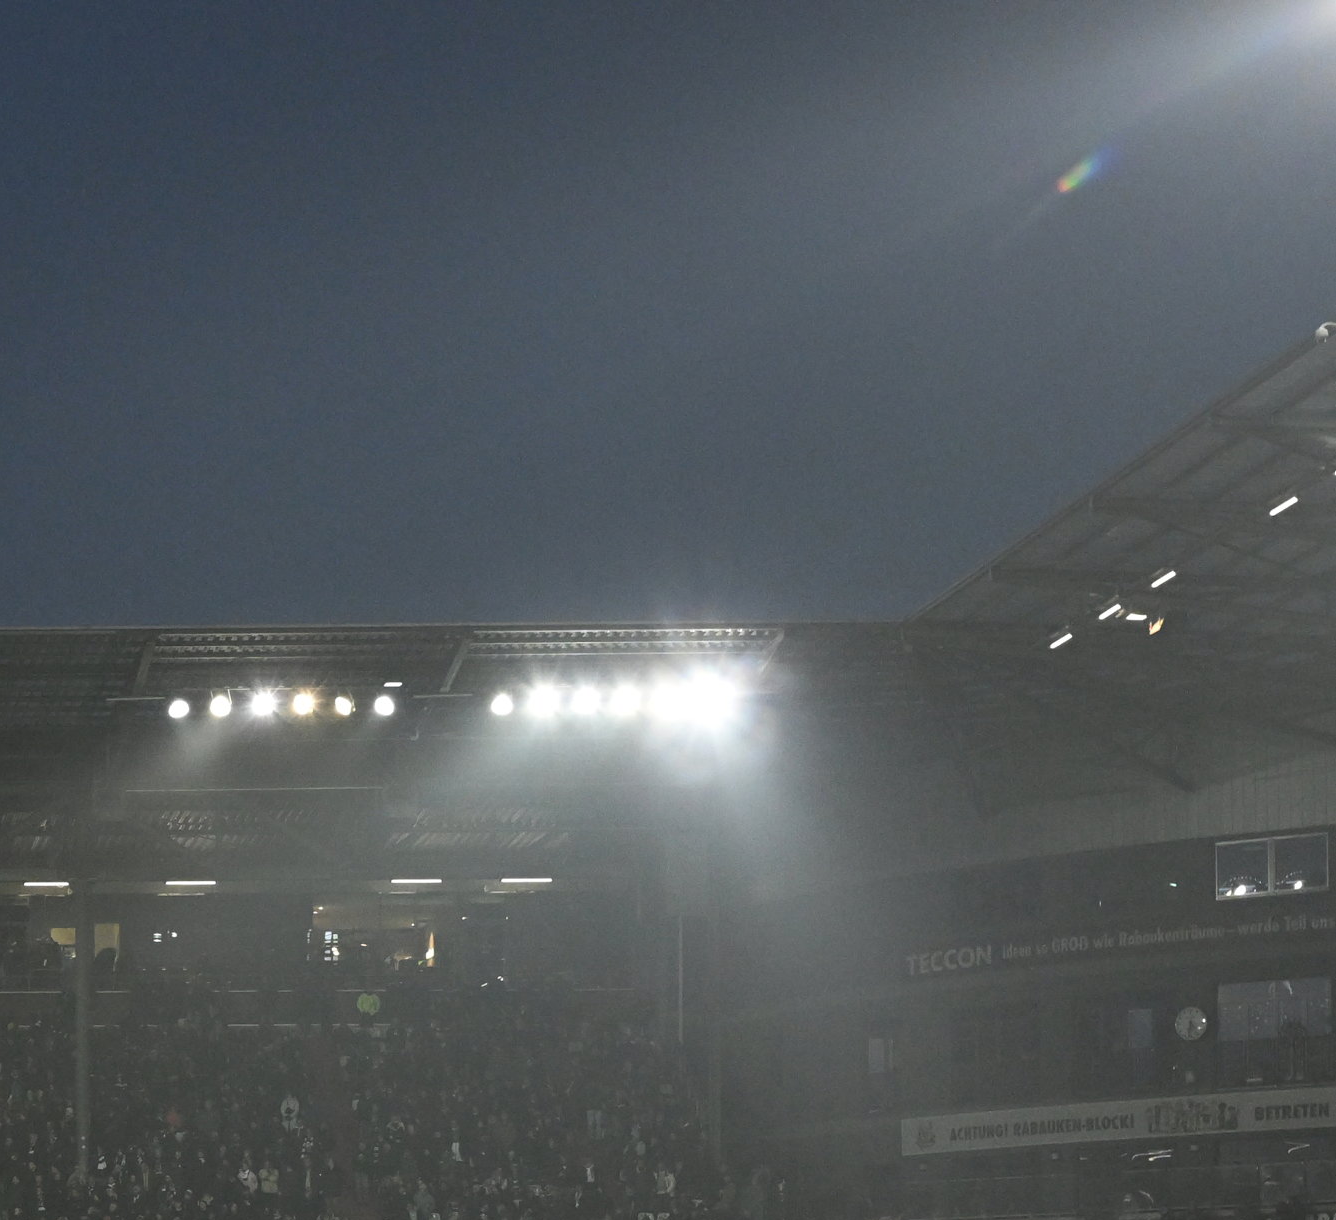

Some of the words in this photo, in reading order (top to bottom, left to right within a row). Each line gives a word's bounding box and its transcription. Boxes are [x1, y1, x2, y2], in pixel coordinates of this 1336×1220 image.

[906, 944, 991, 975] TECCON
[950, 1123, 1008, 1142] ACHTUNG!
[1013, 1113, 1134, 1136] RABAUKEN-BLOCK!
[1253, 1102, 1329, 1121] BETRETEN
